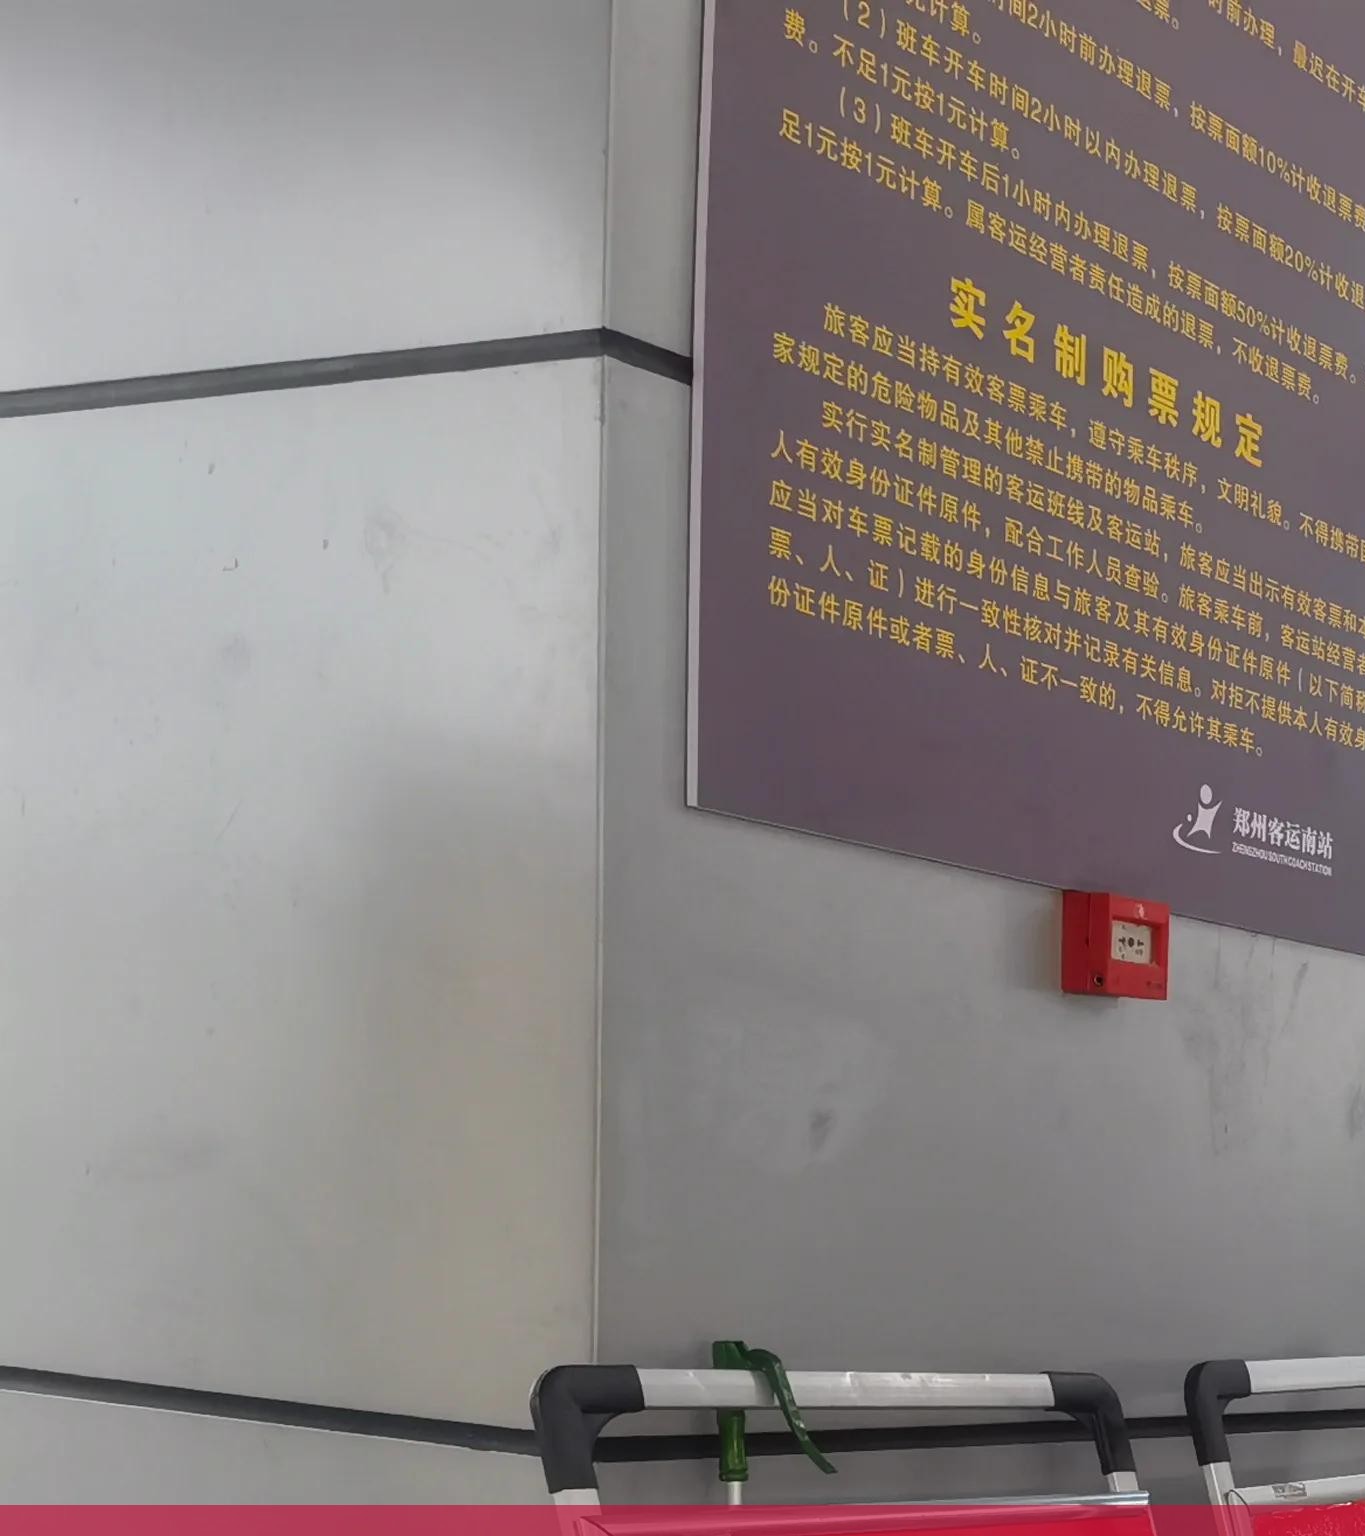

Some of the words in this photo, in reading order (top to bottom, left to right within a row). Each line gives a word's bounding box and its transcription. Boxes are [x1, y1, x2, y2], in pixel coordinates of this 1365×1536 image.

[950, 276, 1263, 468] 实名制购票规定
[1233, 807, 1334, 860] 郑州客运南站
